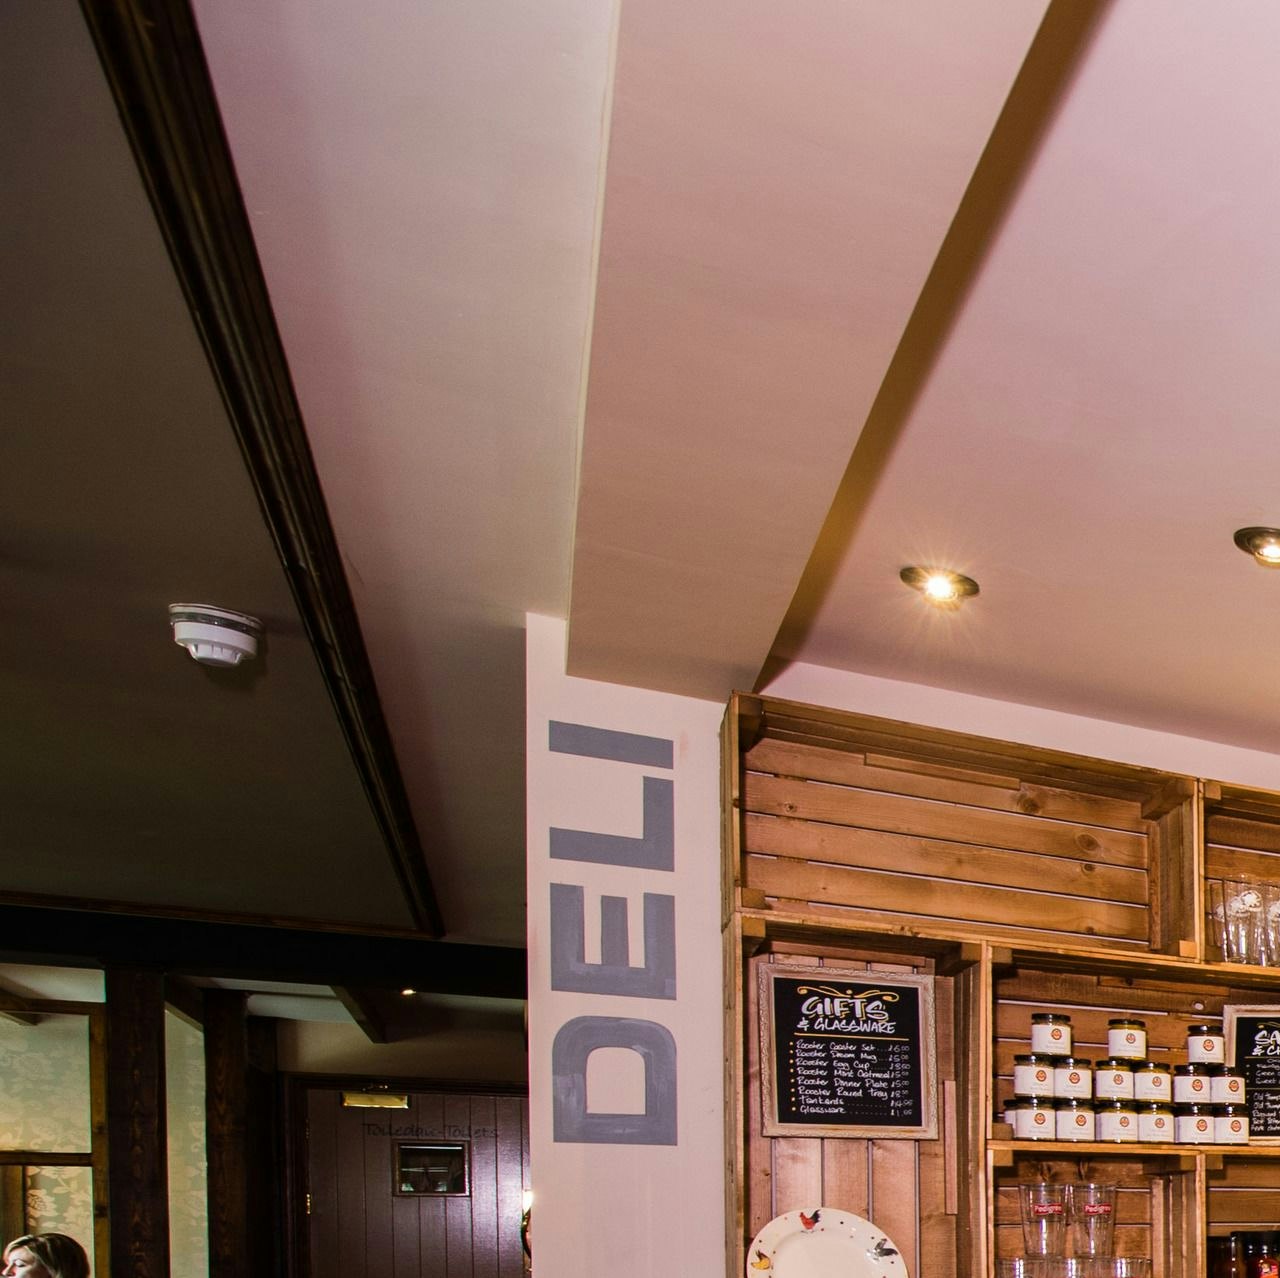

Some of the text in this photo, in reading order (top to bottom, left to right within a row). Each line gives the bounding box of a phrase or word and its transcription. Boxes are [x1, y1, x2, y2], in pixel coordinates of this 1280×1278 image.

[548, 719, 678, 1146] DELI
[801, 996, 889, 1021] GIFTS
[797, 1017, 896, 1034] & GLASSWARE
[829, 1042, 856, 1051] Coaster
[1252, 1045, 1265, 1056] &
[833, 1060, 850, 1071] Egg
[853, 1061, 870, 1069] Cup
[833, 1078, 861, 1087] Dinner
[865, 1078, 889, 1088] Plate
[836, 1087, 863, 1097] Round
